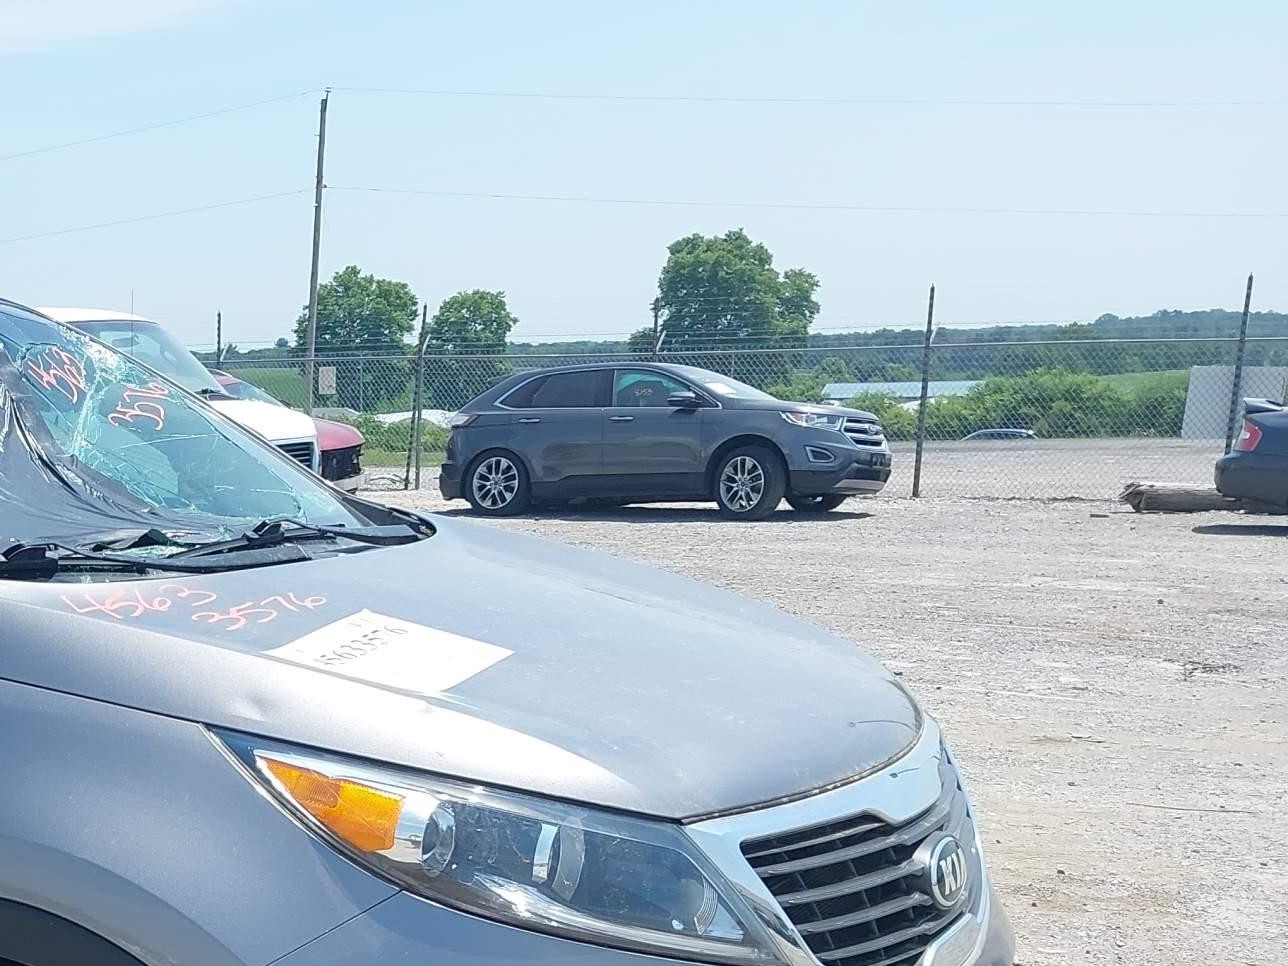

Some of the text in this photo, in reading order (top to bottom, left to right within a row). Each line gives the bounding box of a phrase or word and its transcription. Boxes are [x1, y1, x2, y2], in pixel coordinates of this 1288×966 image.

[107, 378, 170, 431] 3576
[61, 585, 217, 619] 4563
[192, 592, 328, 631] 3576
